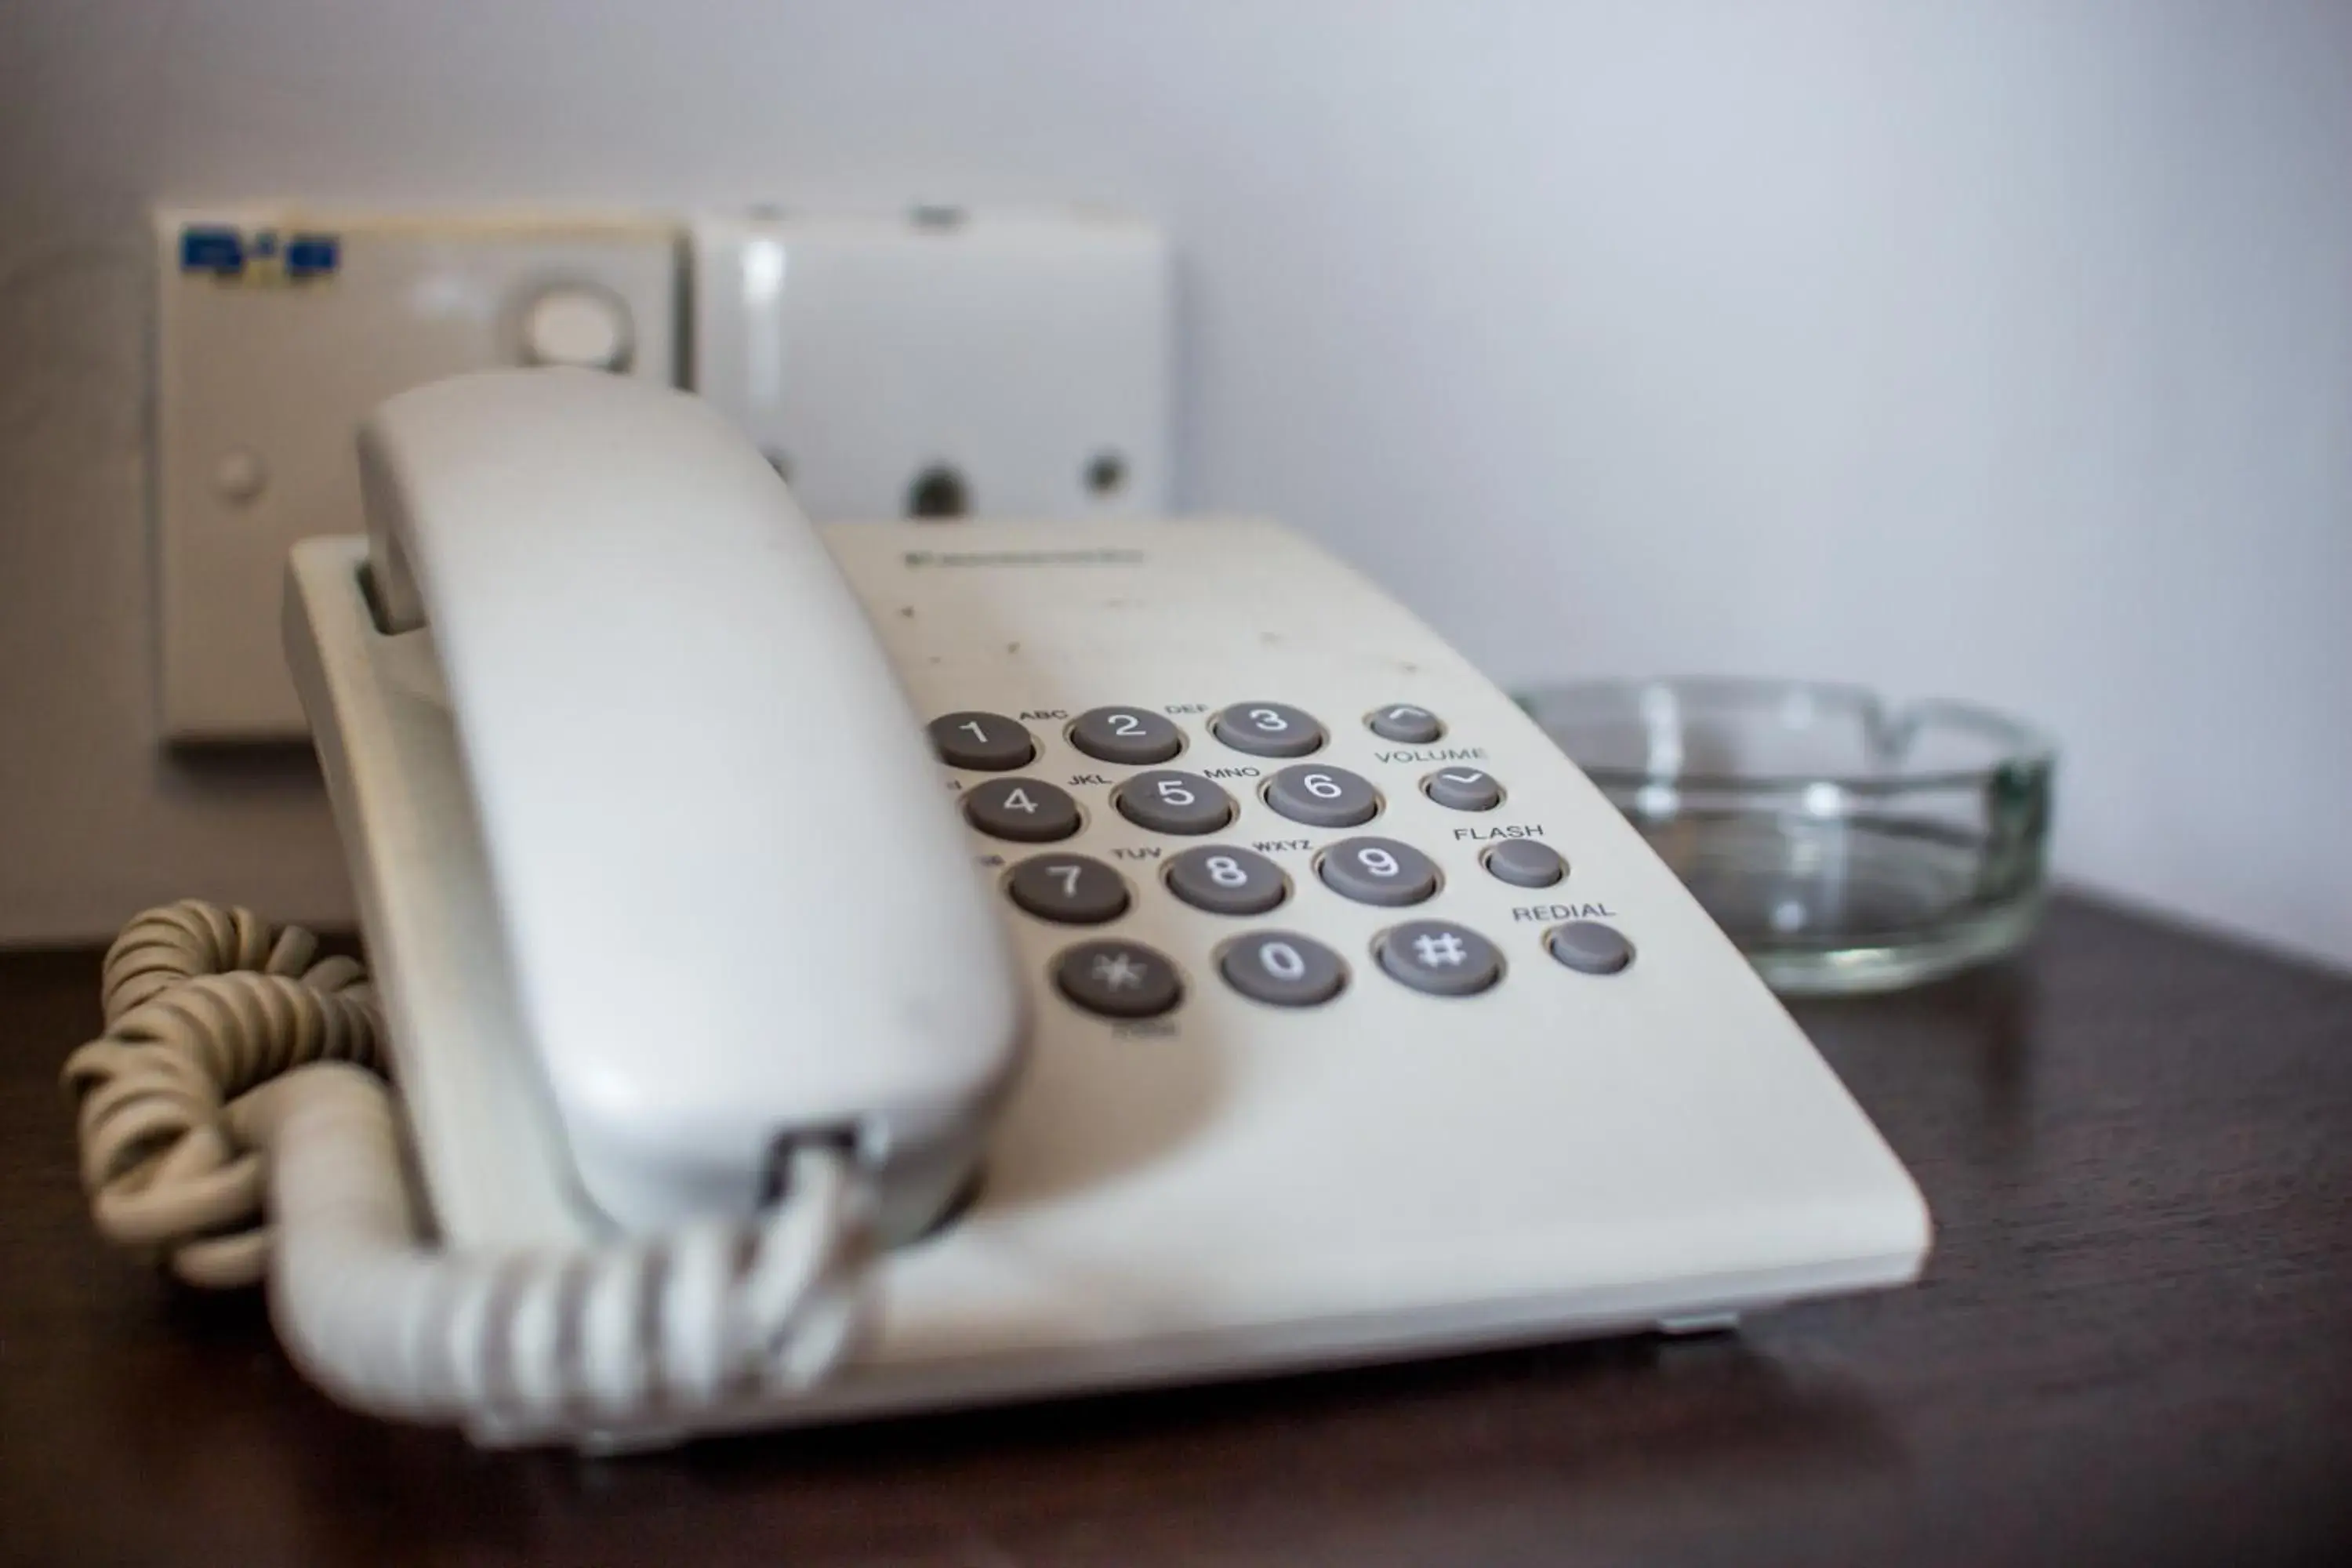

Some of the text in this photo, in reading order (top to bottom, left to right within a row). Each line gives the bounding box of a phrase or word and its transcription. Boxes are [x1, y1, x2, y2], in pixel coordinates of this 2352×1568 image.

[1019, 709, 1069, 721] ABC
[1165, 703, 1209, 715] DEF
[1249, 709, 1288, 731] 3
[959, 720, 989, 744] 1
[1107, 714, 1147, 736] 2
[1374, 748, 1488, 764] VOLUME
[1067, 775, 1114, 786] JKL
[1203, 766, 1261, 779] MNO
[1157, 780, 1196, 806] 5
[1304, 774, 1342, 799] 6
[1004, 788, 1039, 814] 4
[1454, 824, 1544, 841] FLASH
[1112, 847, 1163, 860] TUV
[1253, 839, 1314, 853] WXYZ
[1206, 855, 1249, 888] 8
[1357, 848, 1400, 877] 9
[1045, 865, 1083, 898] 7
[1512, 902, 1617, 922] REDIAL
[1414, 932, 1468, 967] #
[1259, 941, 1306, 981] 0
